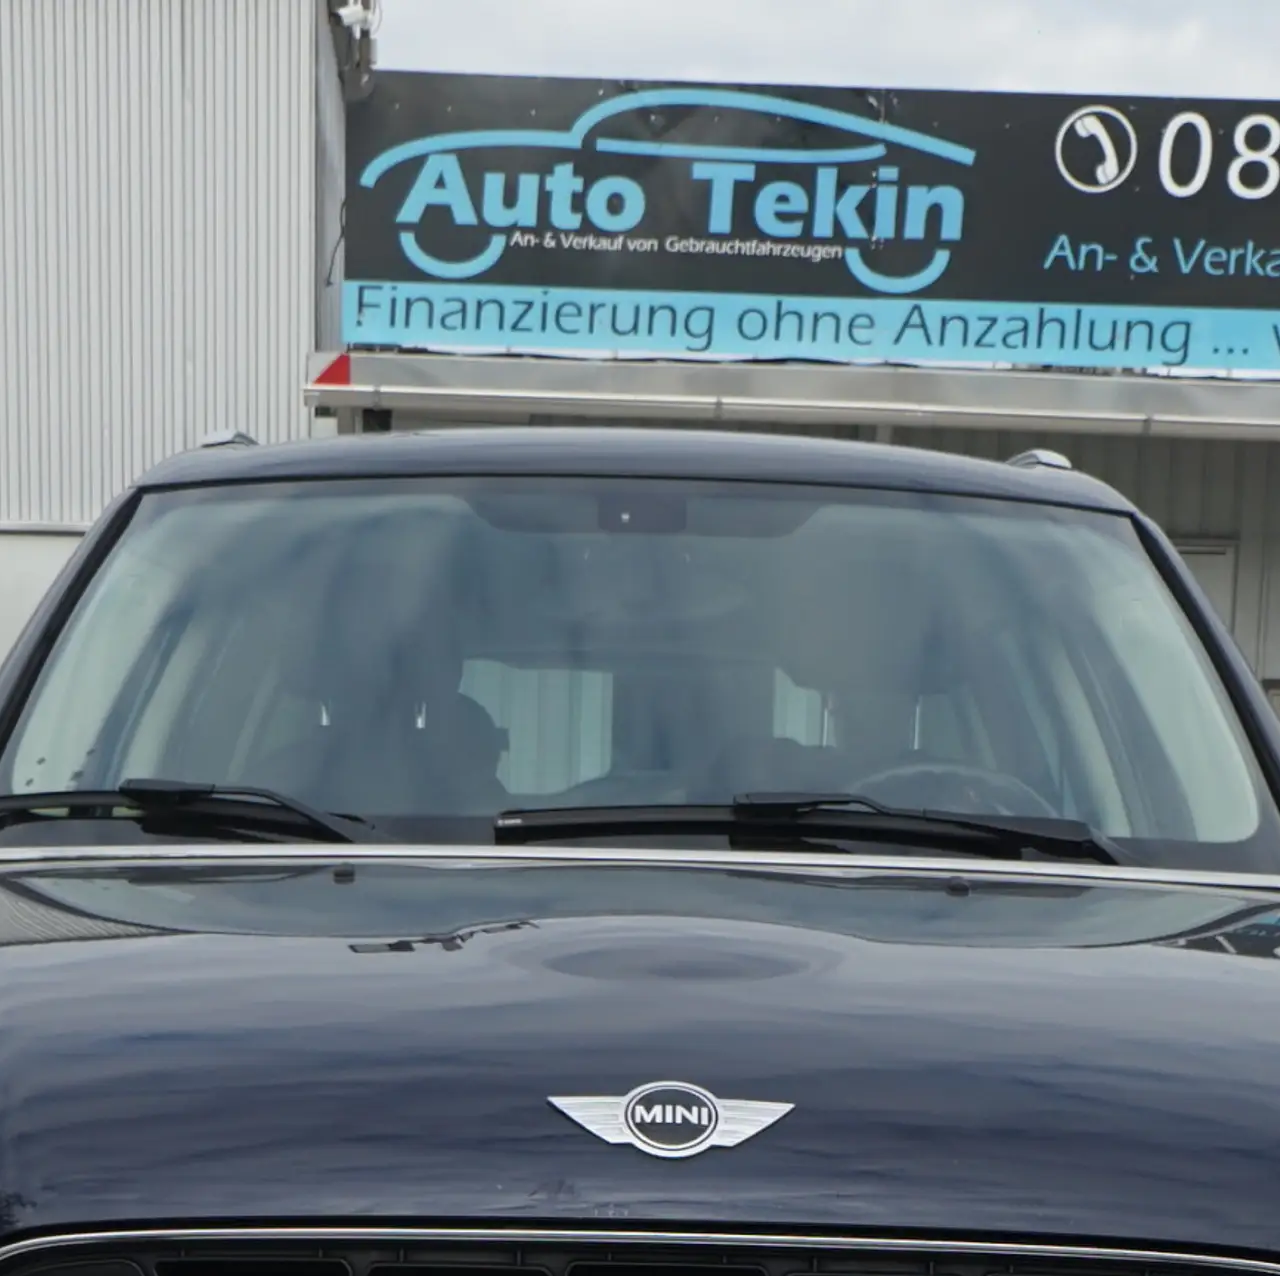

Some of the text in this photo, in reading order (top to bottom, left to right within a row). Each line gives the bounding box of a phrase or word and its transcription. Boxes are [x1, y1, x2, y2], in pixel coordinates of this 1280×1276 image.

[395, 153, 964, 240] Auto Tekin
[510, 233, 843, 262] An- & Verkauf von Gebrauchtfahrzeugen
[1044, 234, 1117, 272] An-
[1130, 237, 1158, 273] &
[356, 286, 715, 352] Finanzierung
[737, 301, 875, 344] ohne
[895, 304, 1192, 366] Anzahlung
[633, 1104, 709, 1126] MINI
